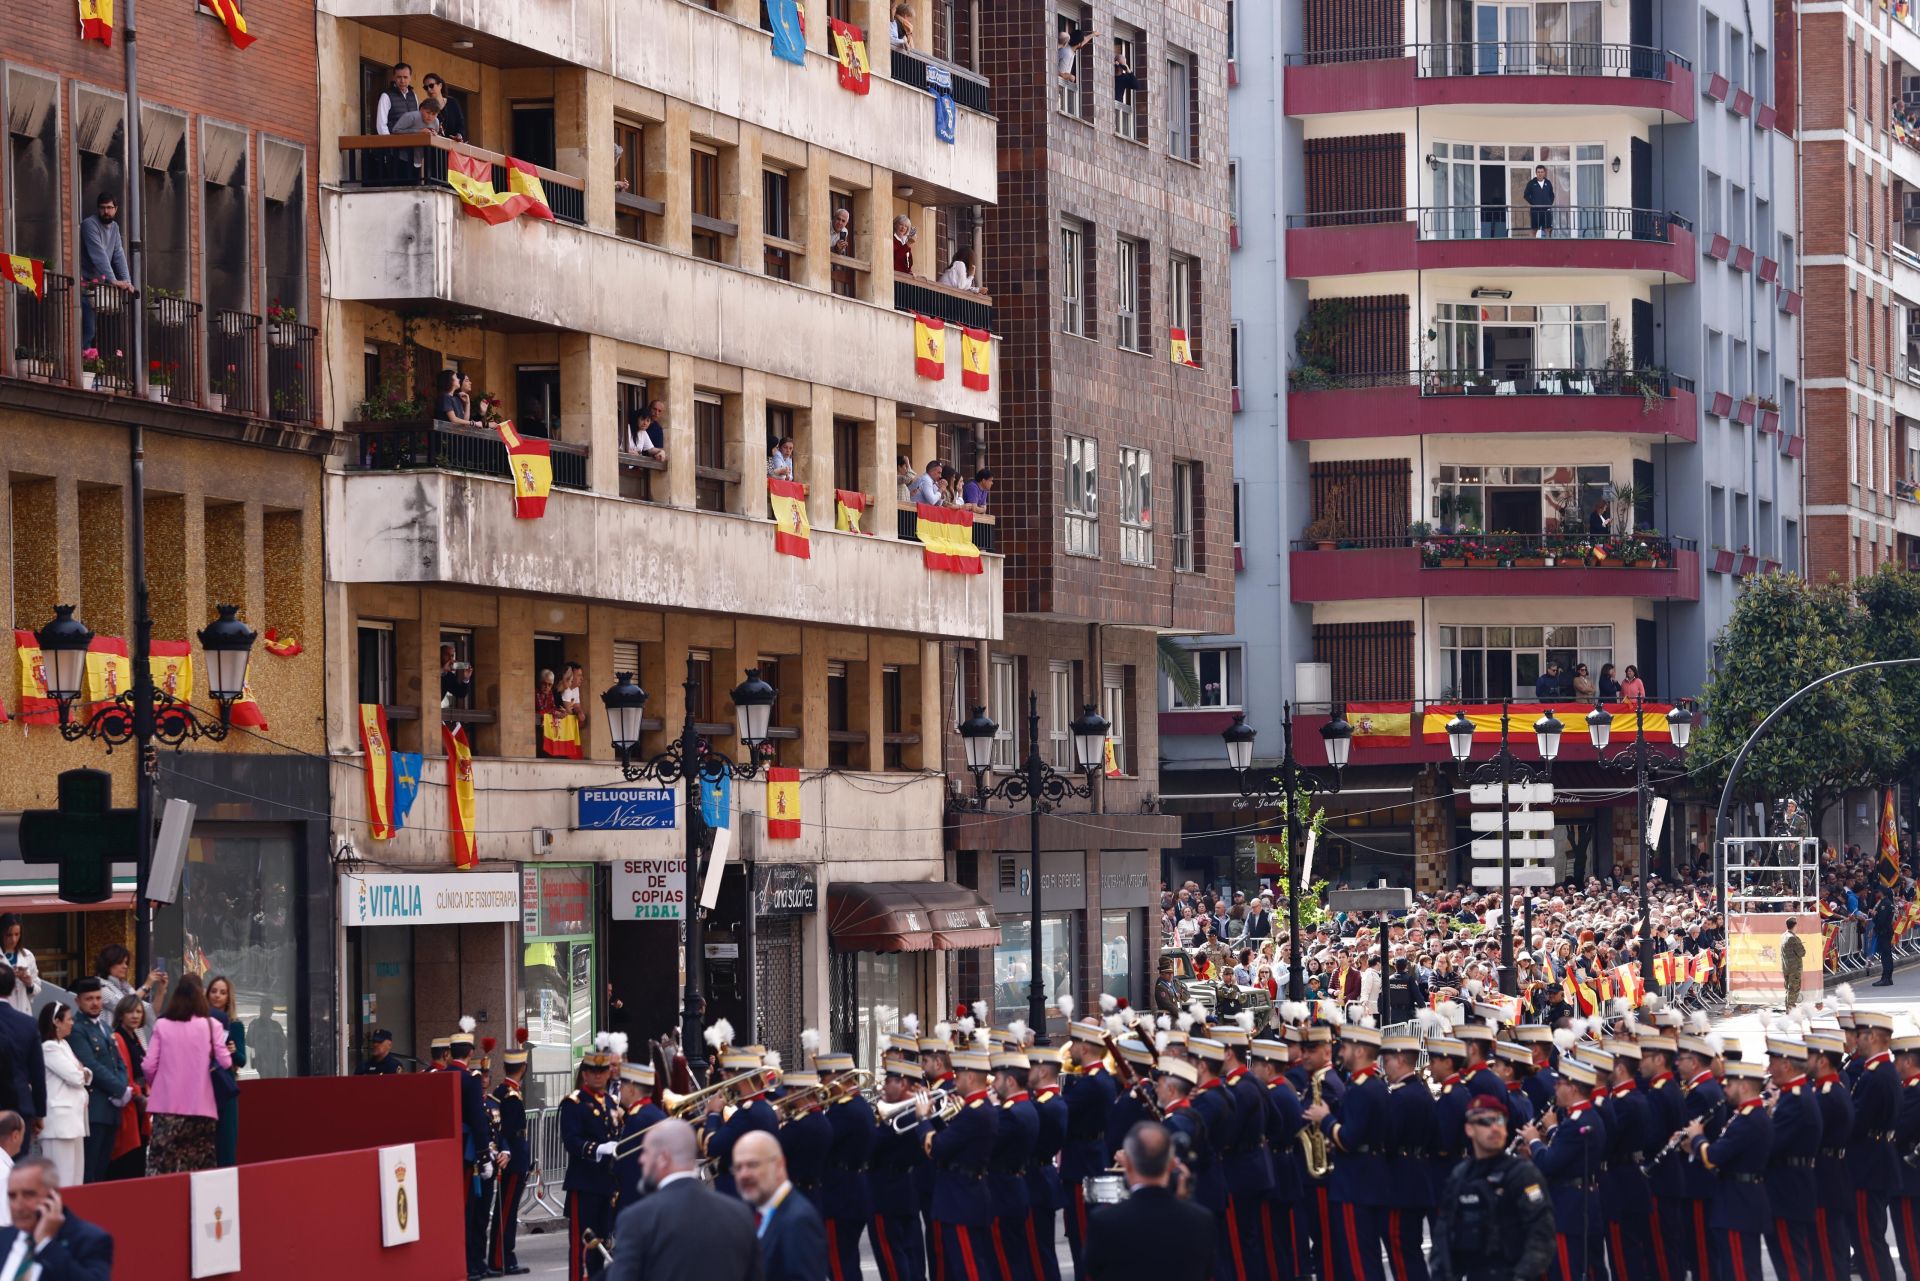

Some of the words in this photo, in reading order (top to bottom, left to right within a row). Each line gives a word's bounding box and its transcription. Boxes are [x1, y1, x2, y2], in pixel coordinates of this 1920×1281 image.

[584, 791, 671, 802] PELUQUERIA
[593, 804, 659, 827] Niza
[648, 875, 667, 888] DE
[369, 884, 422, 917] VITALIA
[436, 888, 464, 909] CLÍNICA
[465, 891, 474, 909] DE
[475, 889, 518, 909] FISIOTERAPIA
[632, 890, 684, 903] COPIAS
[774, 889, 787, 908] ana
[634, 904, 680, 918] PIDAL
